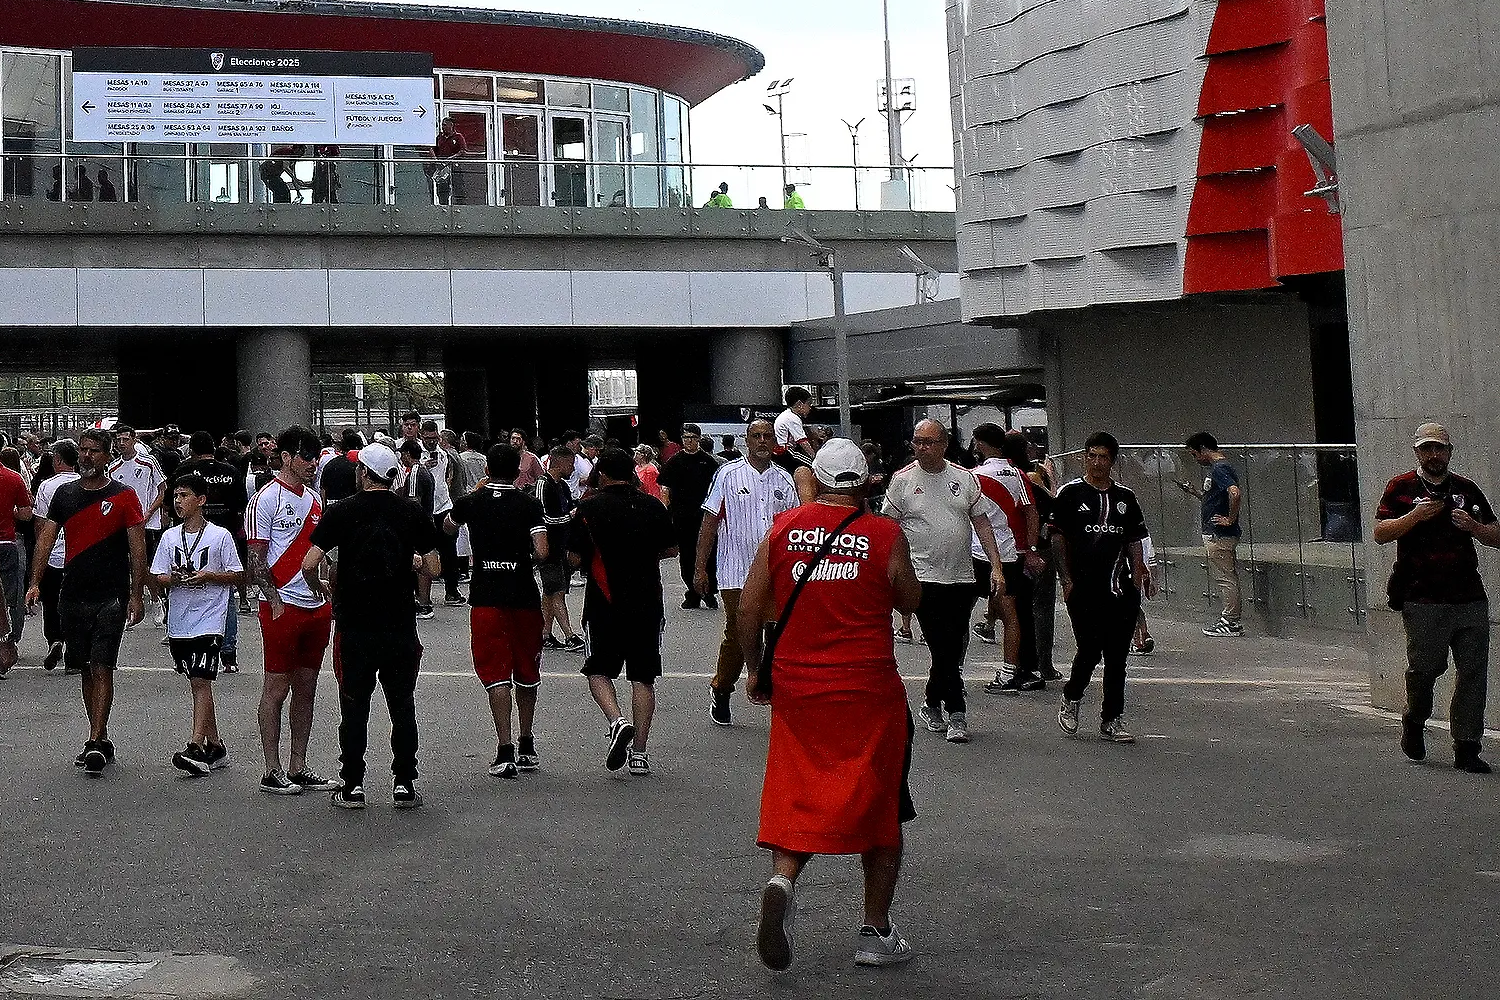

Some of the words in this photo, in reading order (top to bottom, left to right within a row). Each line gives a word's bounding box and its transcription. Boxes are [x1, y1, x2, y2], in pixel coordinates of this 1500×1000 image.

[230, 57, 276, 67] Elecciones
[277, 58, 300, 67] 2025
[831, 548, 869, 559] PLATE
